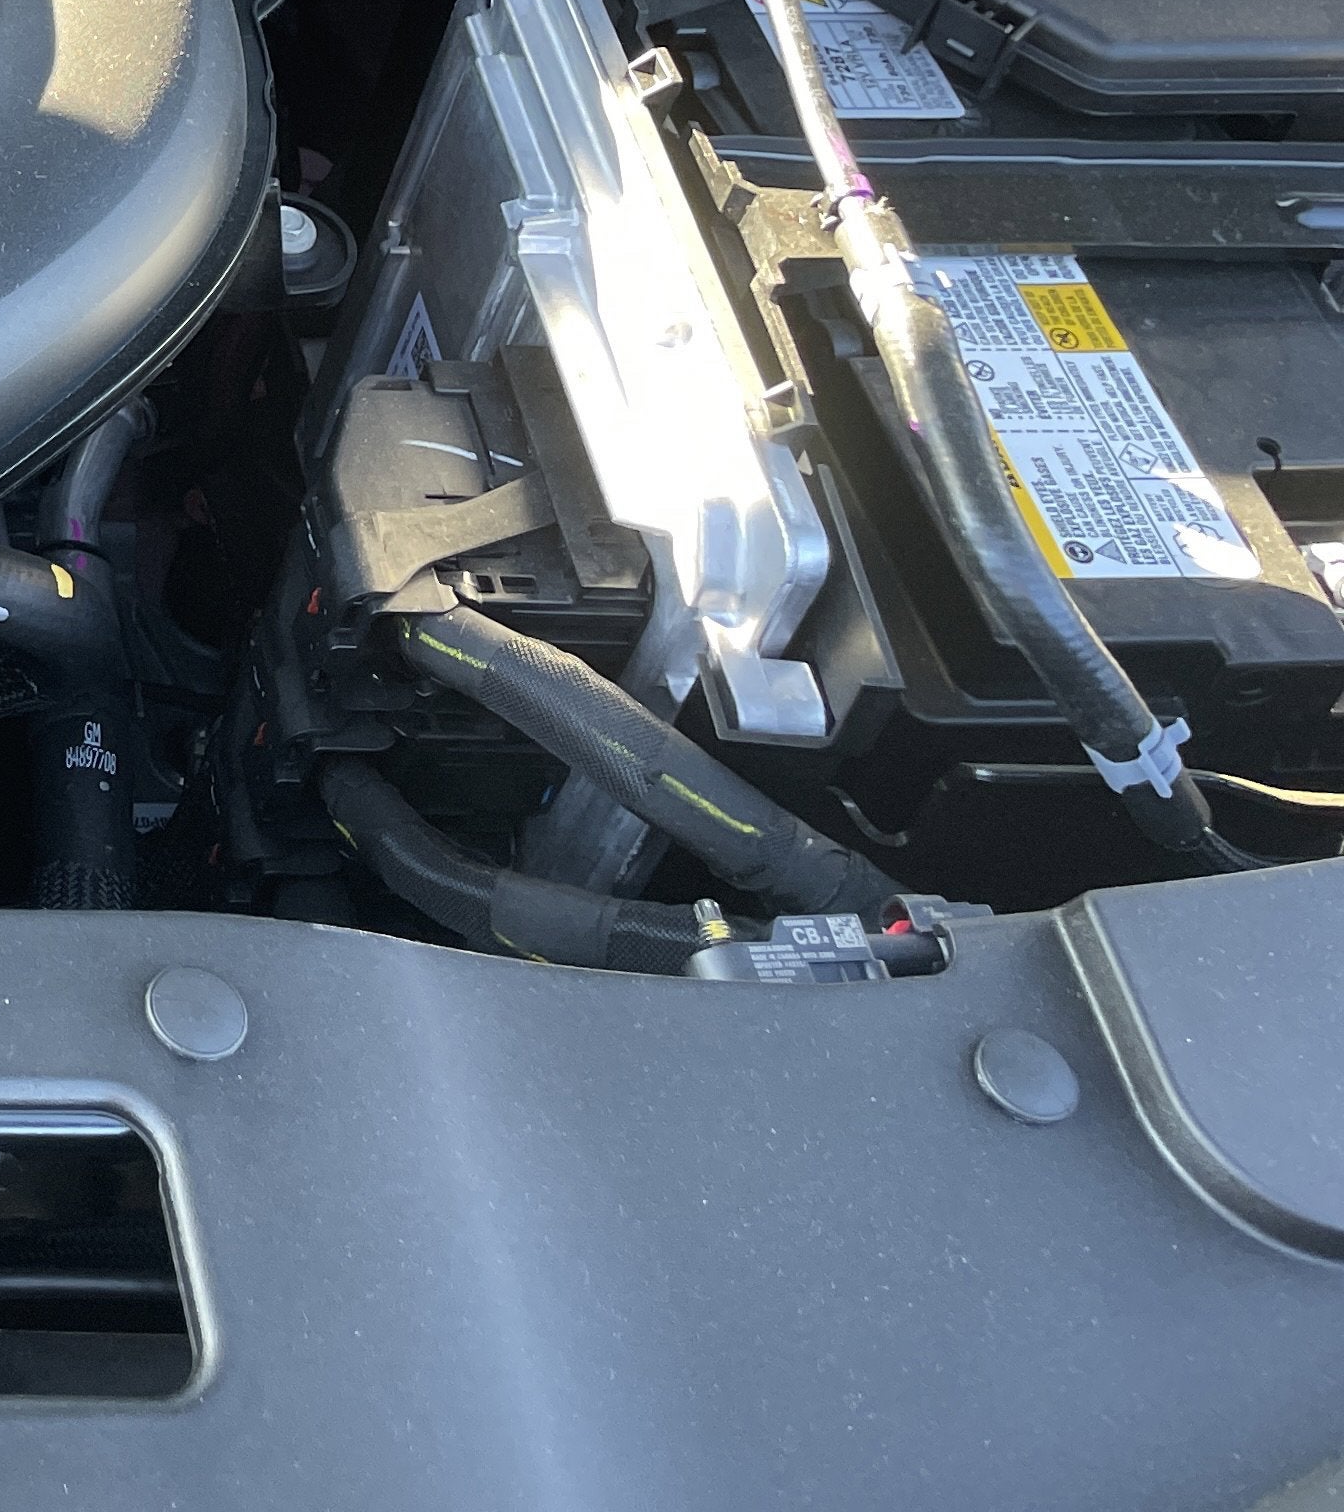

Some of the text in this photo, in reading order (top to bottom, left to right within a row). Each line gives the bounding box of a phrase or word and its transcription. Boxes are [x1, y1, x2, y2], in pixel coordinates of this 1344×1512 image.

[1030, 457, 1086, 537] EXPLOSIVE GASES
[1096, 500, 1116, 515] LES
[1044, 506, 1073, 537] SHIELD
[1126, 527, 1148, 545] GAZ
[1137, 548, 1158, 564] LES
[84, 721, 101, 745] GM
